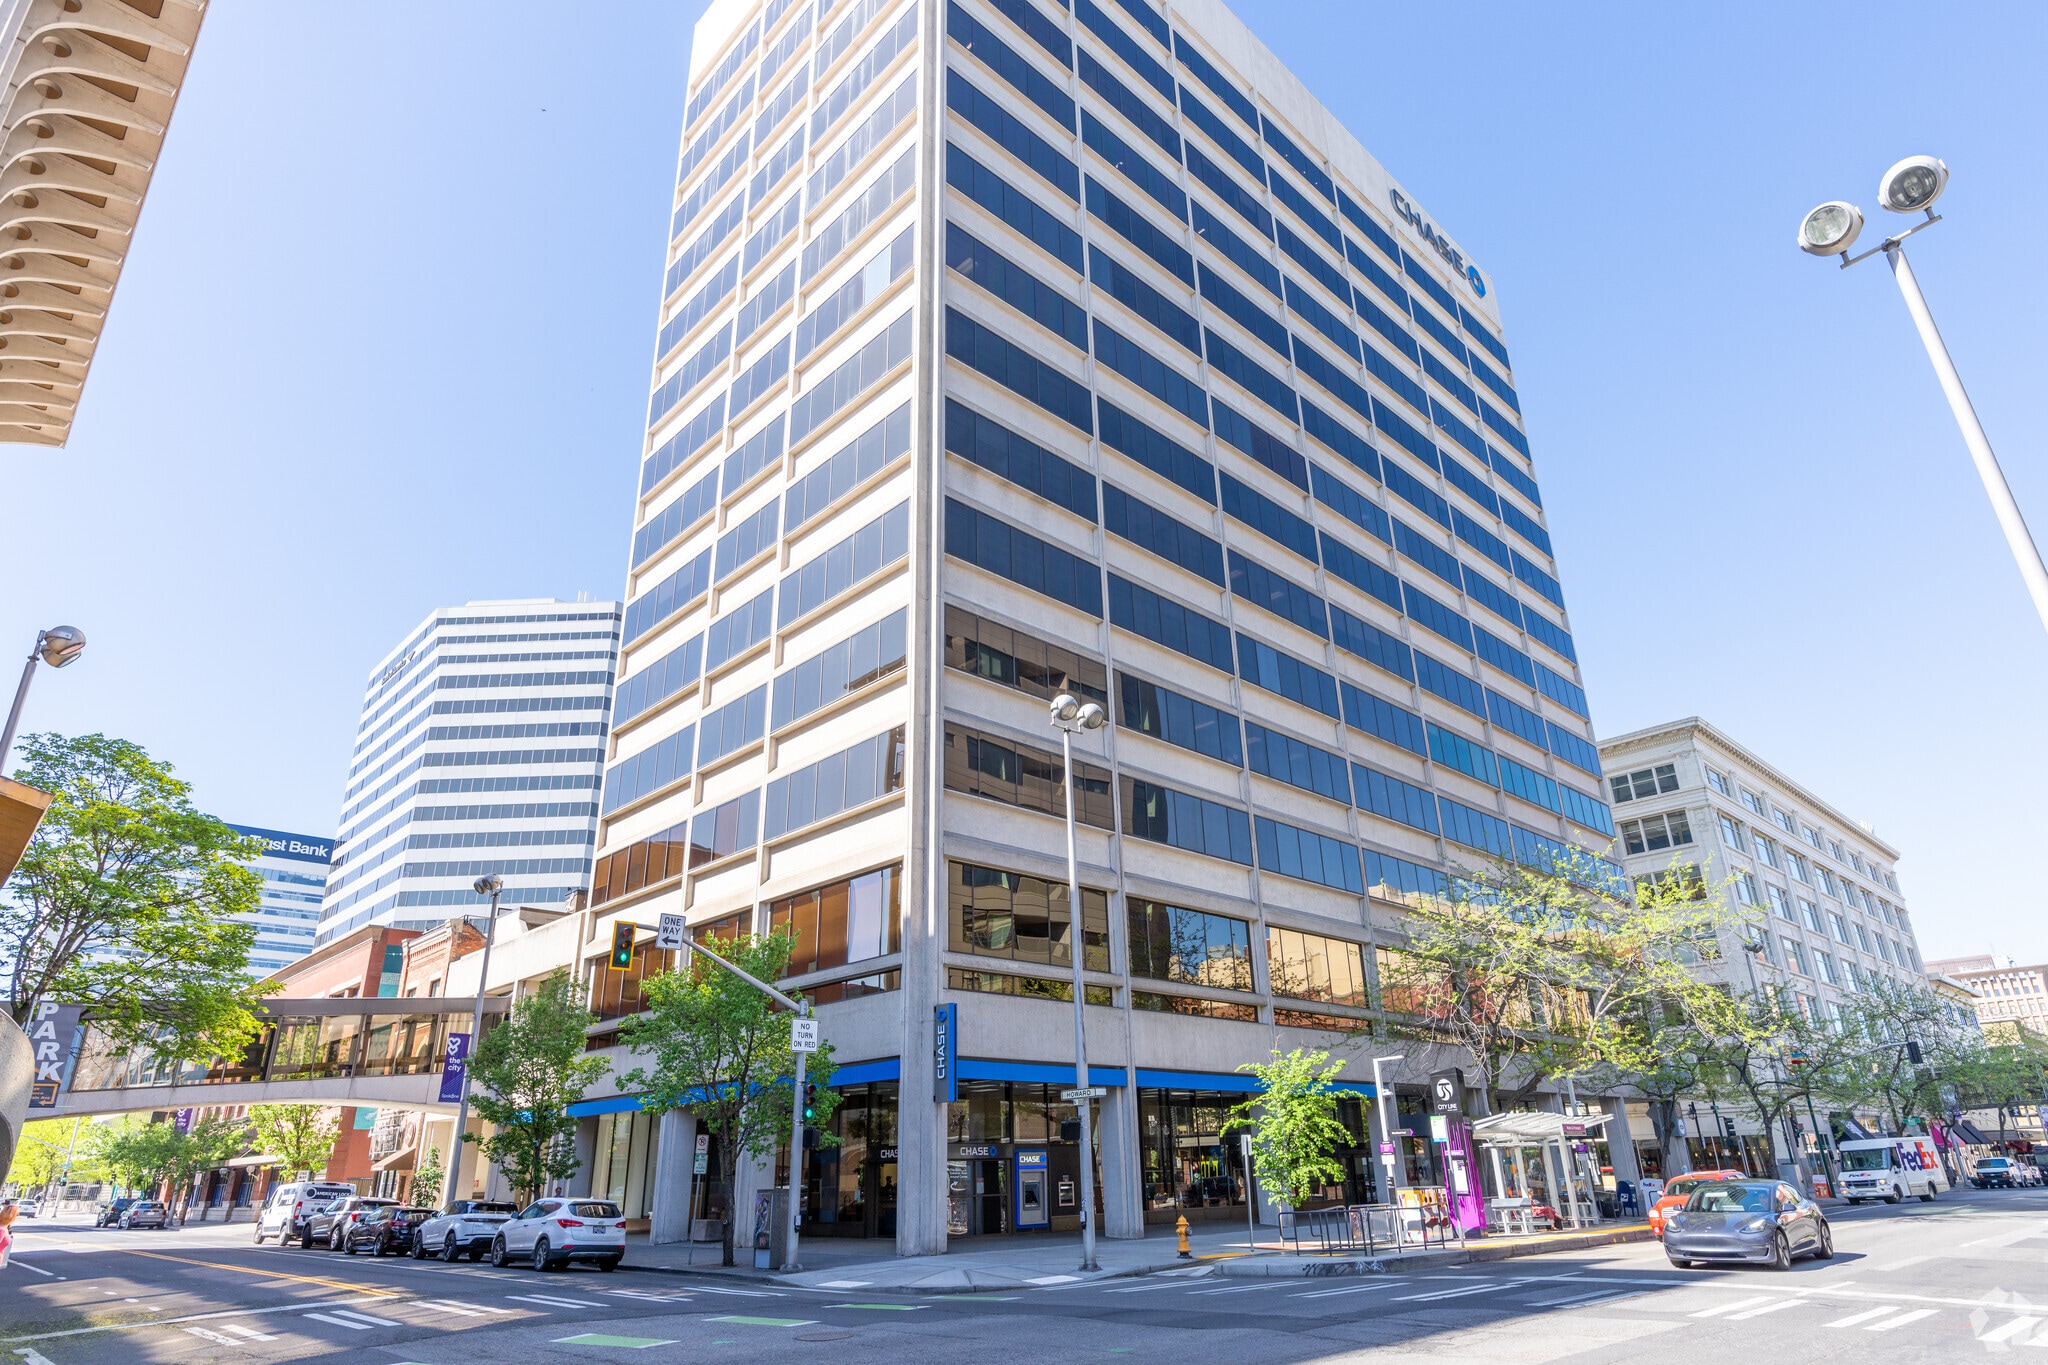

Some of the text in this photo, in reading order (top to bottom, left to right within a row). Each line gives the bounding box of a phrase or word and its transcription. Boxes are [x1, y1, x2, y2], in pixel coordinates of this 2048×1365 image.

[1389, 188, 1467, 280] CHASE
[249, 834, 288, 852] Tust
[288, 840, 330, 858] Bank
[664, 916, 682, 927] ONE
[662, 925, 681, 936] WAY
[797, 1031, 813, 1039] TURN
[32, 1002, 65, 1081] PARK
[793, 1040, 802, 1048] ON
[937, 1024, 946, 1079] CHASE
[447, 1064, 462, 1073] city
[1066, 1089, 1092, 1098] HOWARD
[880, 1149, 898, 1159] CHAS
[960, 1146, 989, 1156] CHASE
[1019, 1155, 1040, 1163] CHASE
[1896, 1141, 1939, 1172] FedEx
